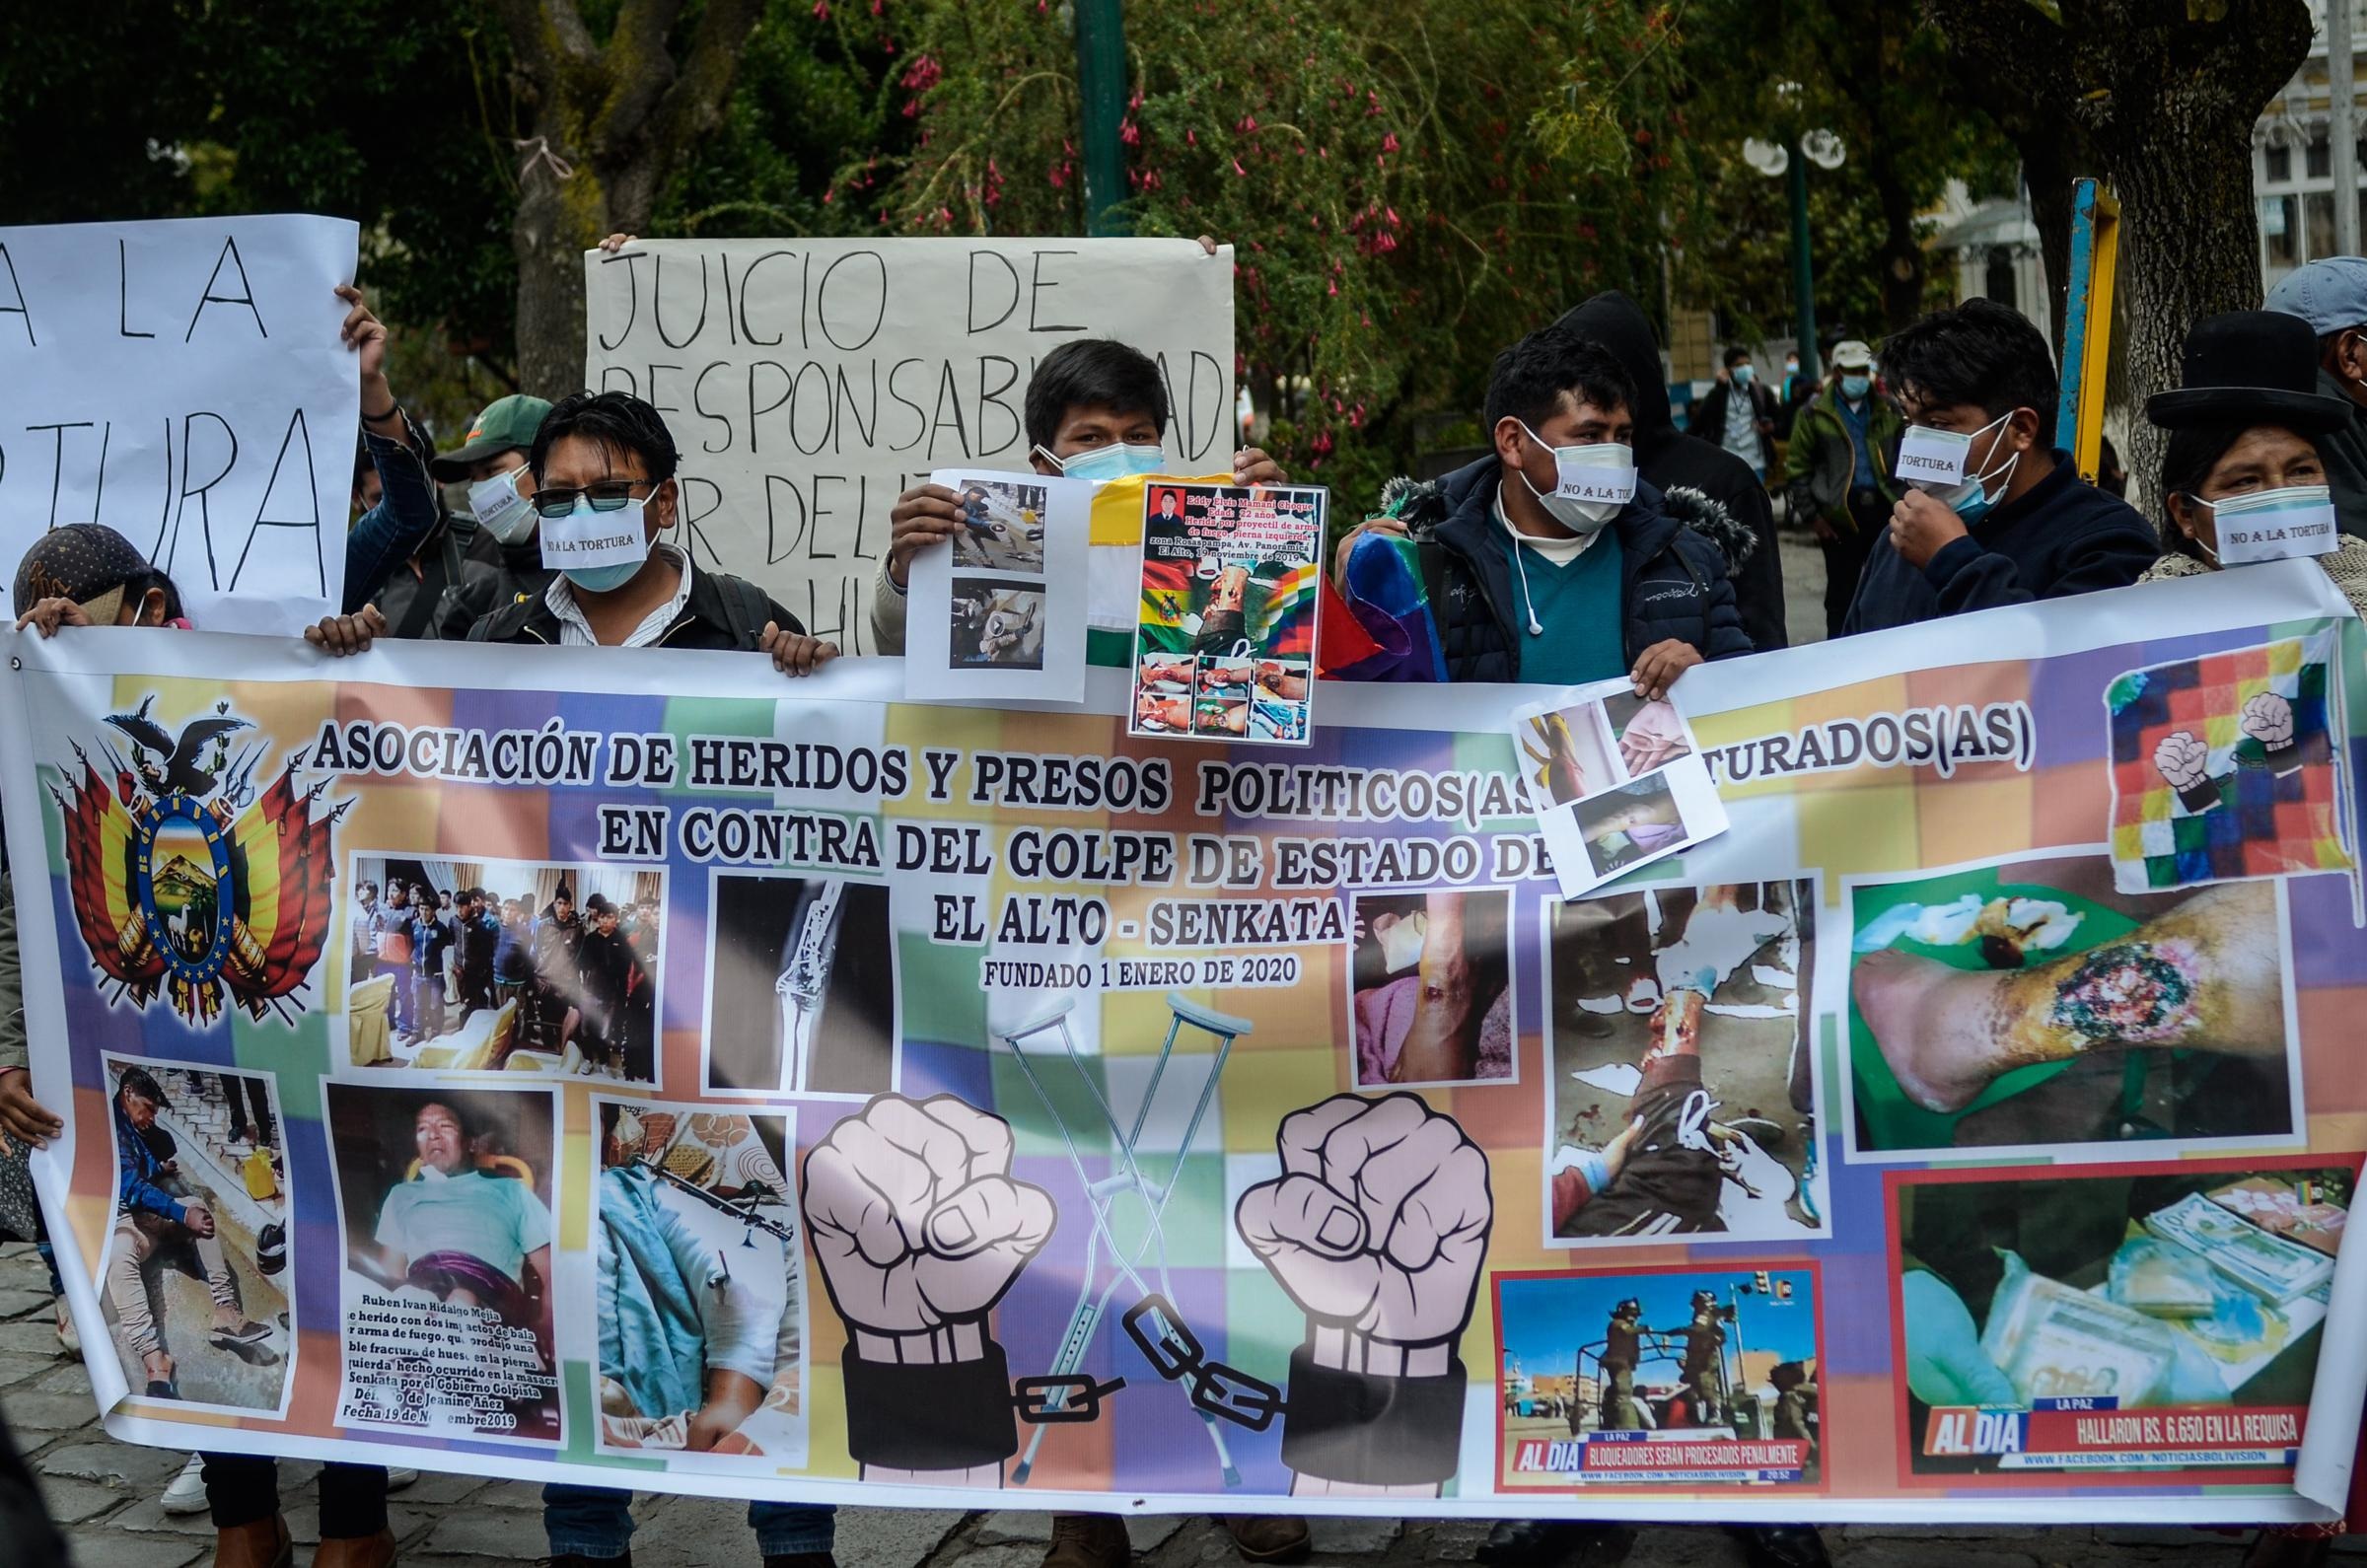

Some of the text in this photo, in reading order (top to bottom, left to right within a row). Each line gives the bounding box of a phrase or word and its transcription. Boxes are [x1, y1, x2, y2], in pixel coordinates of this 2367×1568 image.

[598, 249, 1088, 351] JUICIO DE
[1901, 455, 1955, 472] TORTURA
[1562, 483, 1580, 495] NO
[1583, 486, 1594, 497] A
[1597, 487, 1614, 499] LA
[0, 406, 327, 600] TURA
[1186, 496, 1314, 511] Eddy Elvis Mamani Choque
[1185, 517, 1216, 526] Herida
[1219, 520, 1235, 529] por
[1237, 520, 1278, 530] proyectil
[1255, 511, 1276, 520] años
[562, 539, 577, 552] LA
[578, 534, 635, 551] TORTURA
[1175, 536, 1235, 549] Rosaspampa,
[1238, 540, 1253, 549] Av.
[1188, 527, 1200, 535] de
[1233, 530, 1262, 539] pierna
[2230, 523, 2331, 544] NO A LA TORTURA
[1159, 546, 1170, 555] El
[1171, 546, 1194, 558] Alto,
[1196, 548, 1208, 557] 19
[1211, 549, 1259, 560] noviembre
[1262, 551, 1273, 560] de
[312, 721, 597, 781] ASOCIACIÓN
[609, 737, 676, 783] DE
[690, 739, 908, 796] HERIDOS
[924, 751, 959, 800] Y
[971, 754, 1169, 810] PRESOS
[602, 809, 666, 856] EN
[682, 811, 881, 868] CONTRA
[896, 823, 993, 876] DEL
[1008, 830, 1175, 883] GOLPE
[1190, 838, 1259, 885] DE
[1276, 839, 1477, 886] ESTADO
[933, 893, 986, 942] EL
[997, 897, 1108, 947] ALTO
[1149, 900, 1345, 947] SENKATA
[983, 957, 1297, 988] FUNDADO 1 ENERO DE 2020
[362, 1294, 400, 1309] Ruben
[402, 1298, 427, 1311] Ivan
[429, 1302, 469, 1317] Hidalgo
[358, 1310, 398, 1324] herido
[400, 1317, 422, 1325] con
[424, 1317, 444, 1328] dos
[495, 1325, 508, 1337] de
[510, 1328, 536, 1341] bala
[357, 1326, 390, 1337] arma
[392, 1327, 407, 1339] de
[513, 1343, 535, 1354] una
[421, 1346, 436, 1358] de
[474, 1354, 487, 1364] en
[489, 1353, 500, 1365] la
[502, 1356, 537, 1370] pierna
[396, 1360, 433, 1375] hecho
[435, 1365, 485, 1379] ocurrido
[487, 1370, 501, 1381] en
[503, 1370, 514, 1382] la
[348, 1371, 540, 1398] Senkata por el Gobierno Golpista
[408, 1391, 423, 1404] de
[425, 1392, 471, 1408] Jeanine
[473, 1396, 503, 1410] Añez
[2055, 1397, 2094, 1410] LA PAZ
[342, 1404, 382, 1420] Fecha
[385, 1408, 399, 1420] 19
[401, 1408, 417, 1421] de
[1605, 1433, 1616, 1442] LA
[1932, 1412, 2021, 1454] AL DIA
[2077, 1413, 2299, 1445] HALLARON BS. 6.650 EN LA REQUISA
[1518, 1442, 1579, 1471] AL DIA
[1589, 1446, 1655, 1467] BLOQUEADORES
[1685, 1445, 1741, 1465] PROCESADOS
[1741, 1444, 1799, 1465] PENALMENTE
